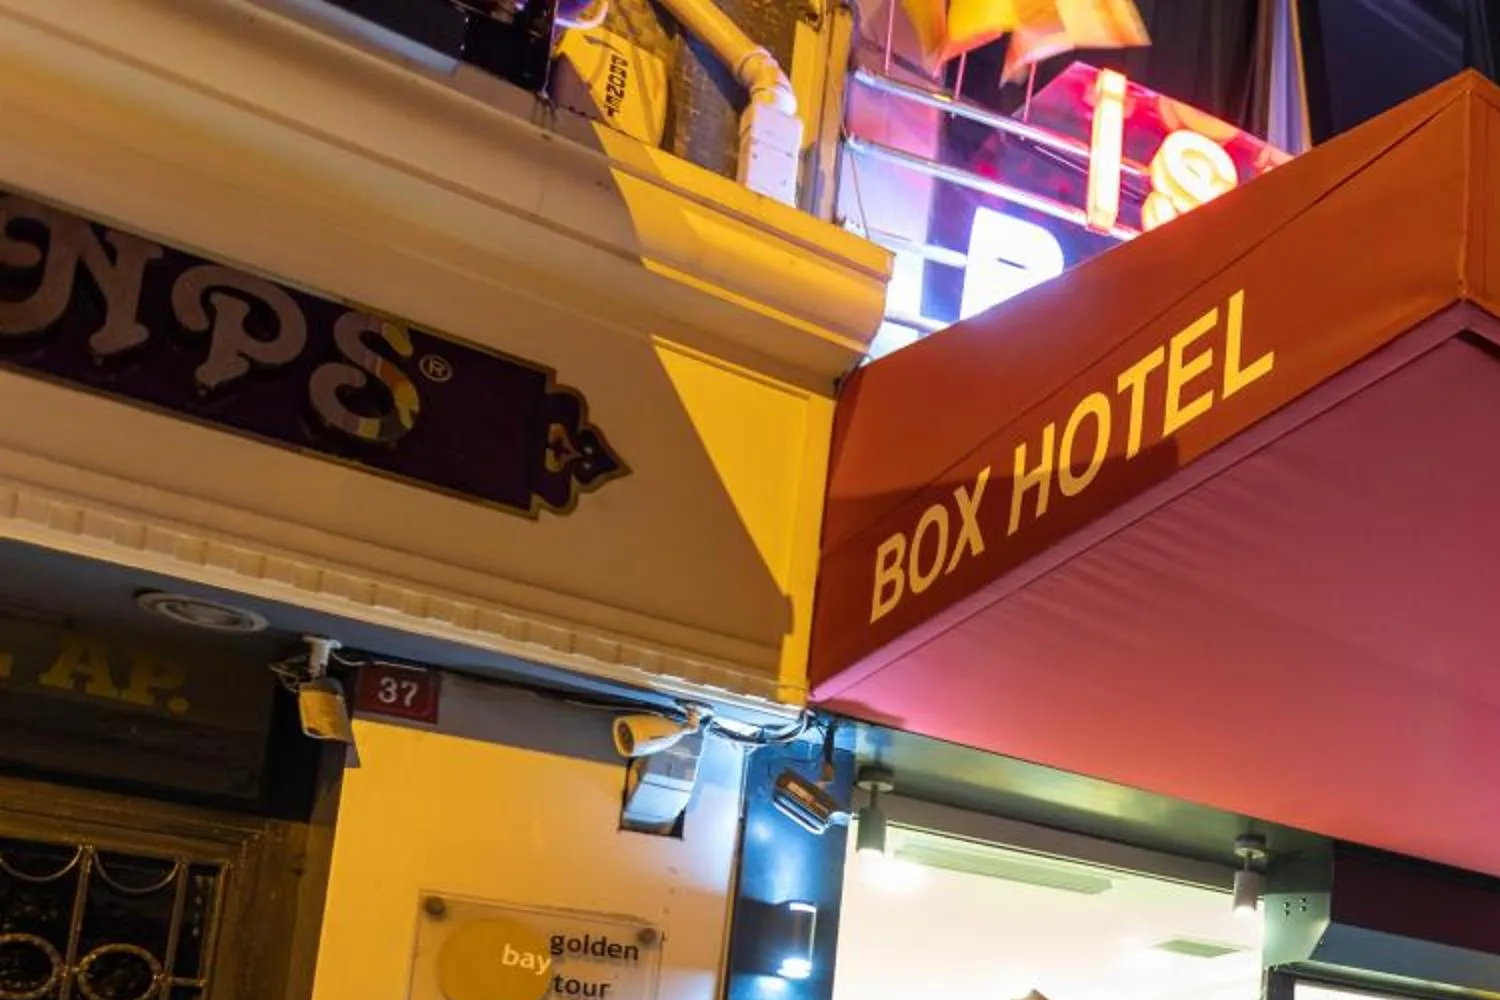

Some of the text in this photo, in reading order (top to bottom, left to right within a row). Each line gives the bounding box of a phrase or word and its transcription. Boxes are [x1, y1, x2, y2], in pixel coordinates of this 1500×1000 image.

[870, 289, 1274, 624] BOX HOTEL
[377, 675, 417, 708] 37
[502, 943, 552, 975] bay
[550, 933, 639, 962] golden
[554, 973, 611, 999] tour
